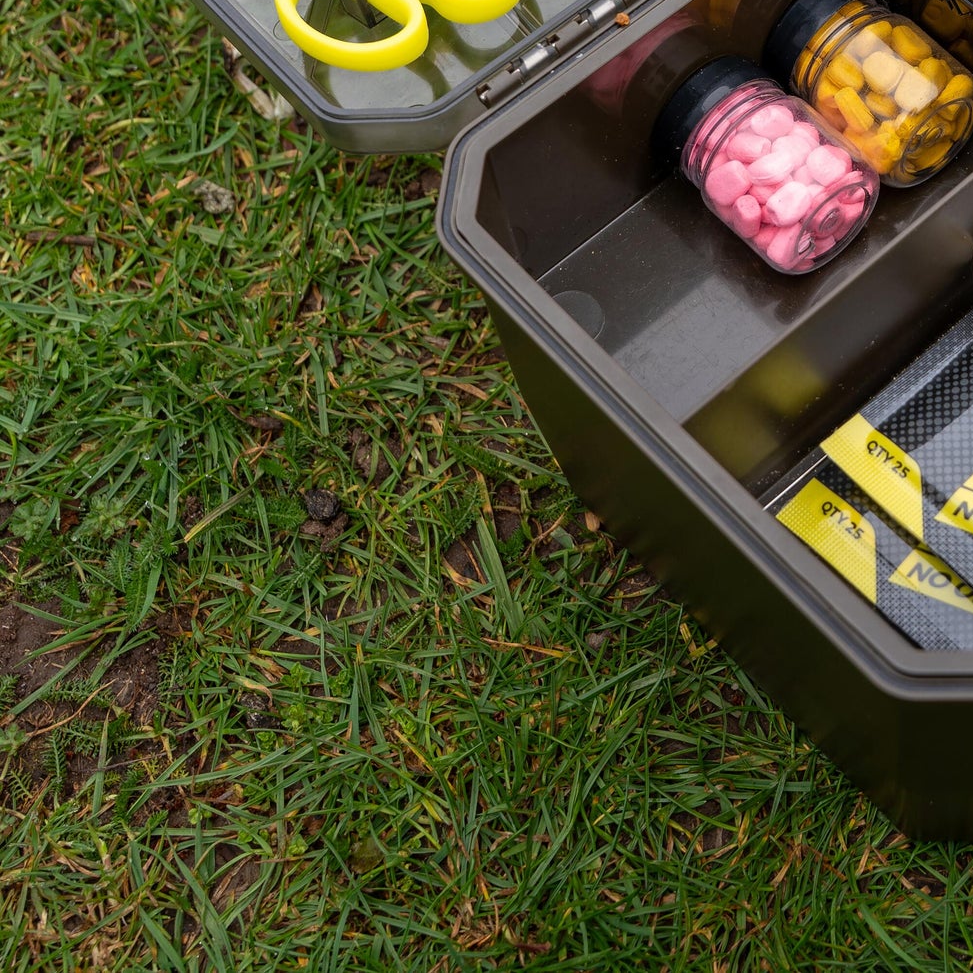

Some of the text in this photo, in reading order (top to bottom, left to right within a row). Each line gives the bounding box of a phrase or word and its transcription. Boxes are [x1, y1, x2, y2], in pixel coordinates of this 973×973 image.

[866, 440, 911, 479] QTY 25
[820, 501, 865, 540] QTY 25
[906, 562, 952, 589] NO
